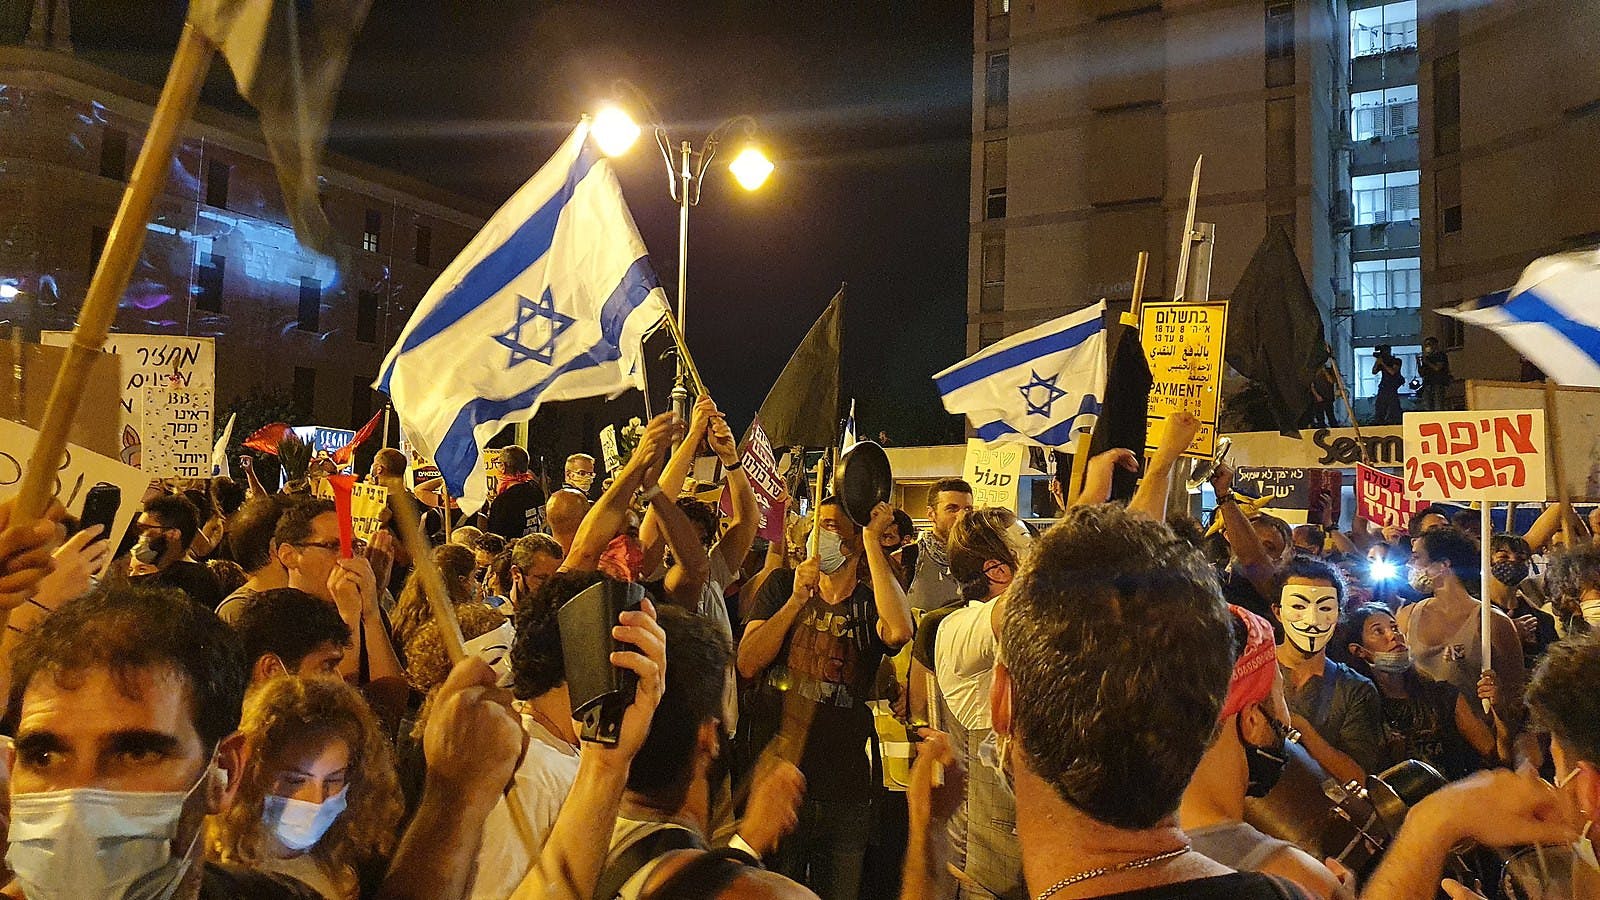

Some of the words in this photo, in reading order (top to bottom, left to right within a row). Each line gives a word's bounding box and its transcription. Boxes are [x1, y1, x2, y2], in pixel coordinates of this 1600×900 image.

[1156, 308, 1208, 323] בתשלום
[1150, 382, 1203, 399] PAYMENT
[174, 409, 209, 420] ראינו
[167, 422, 198, 437] ממך
[1419, 414, 1538, 455] איפה
[174, 439, 188, 449] די
[173, 466, 199, 477] מדי
[743, 455, 767, 484] כולנו
[767, 478, 780, 497] של
[1405, 456, 1526, 498] הכסף?
